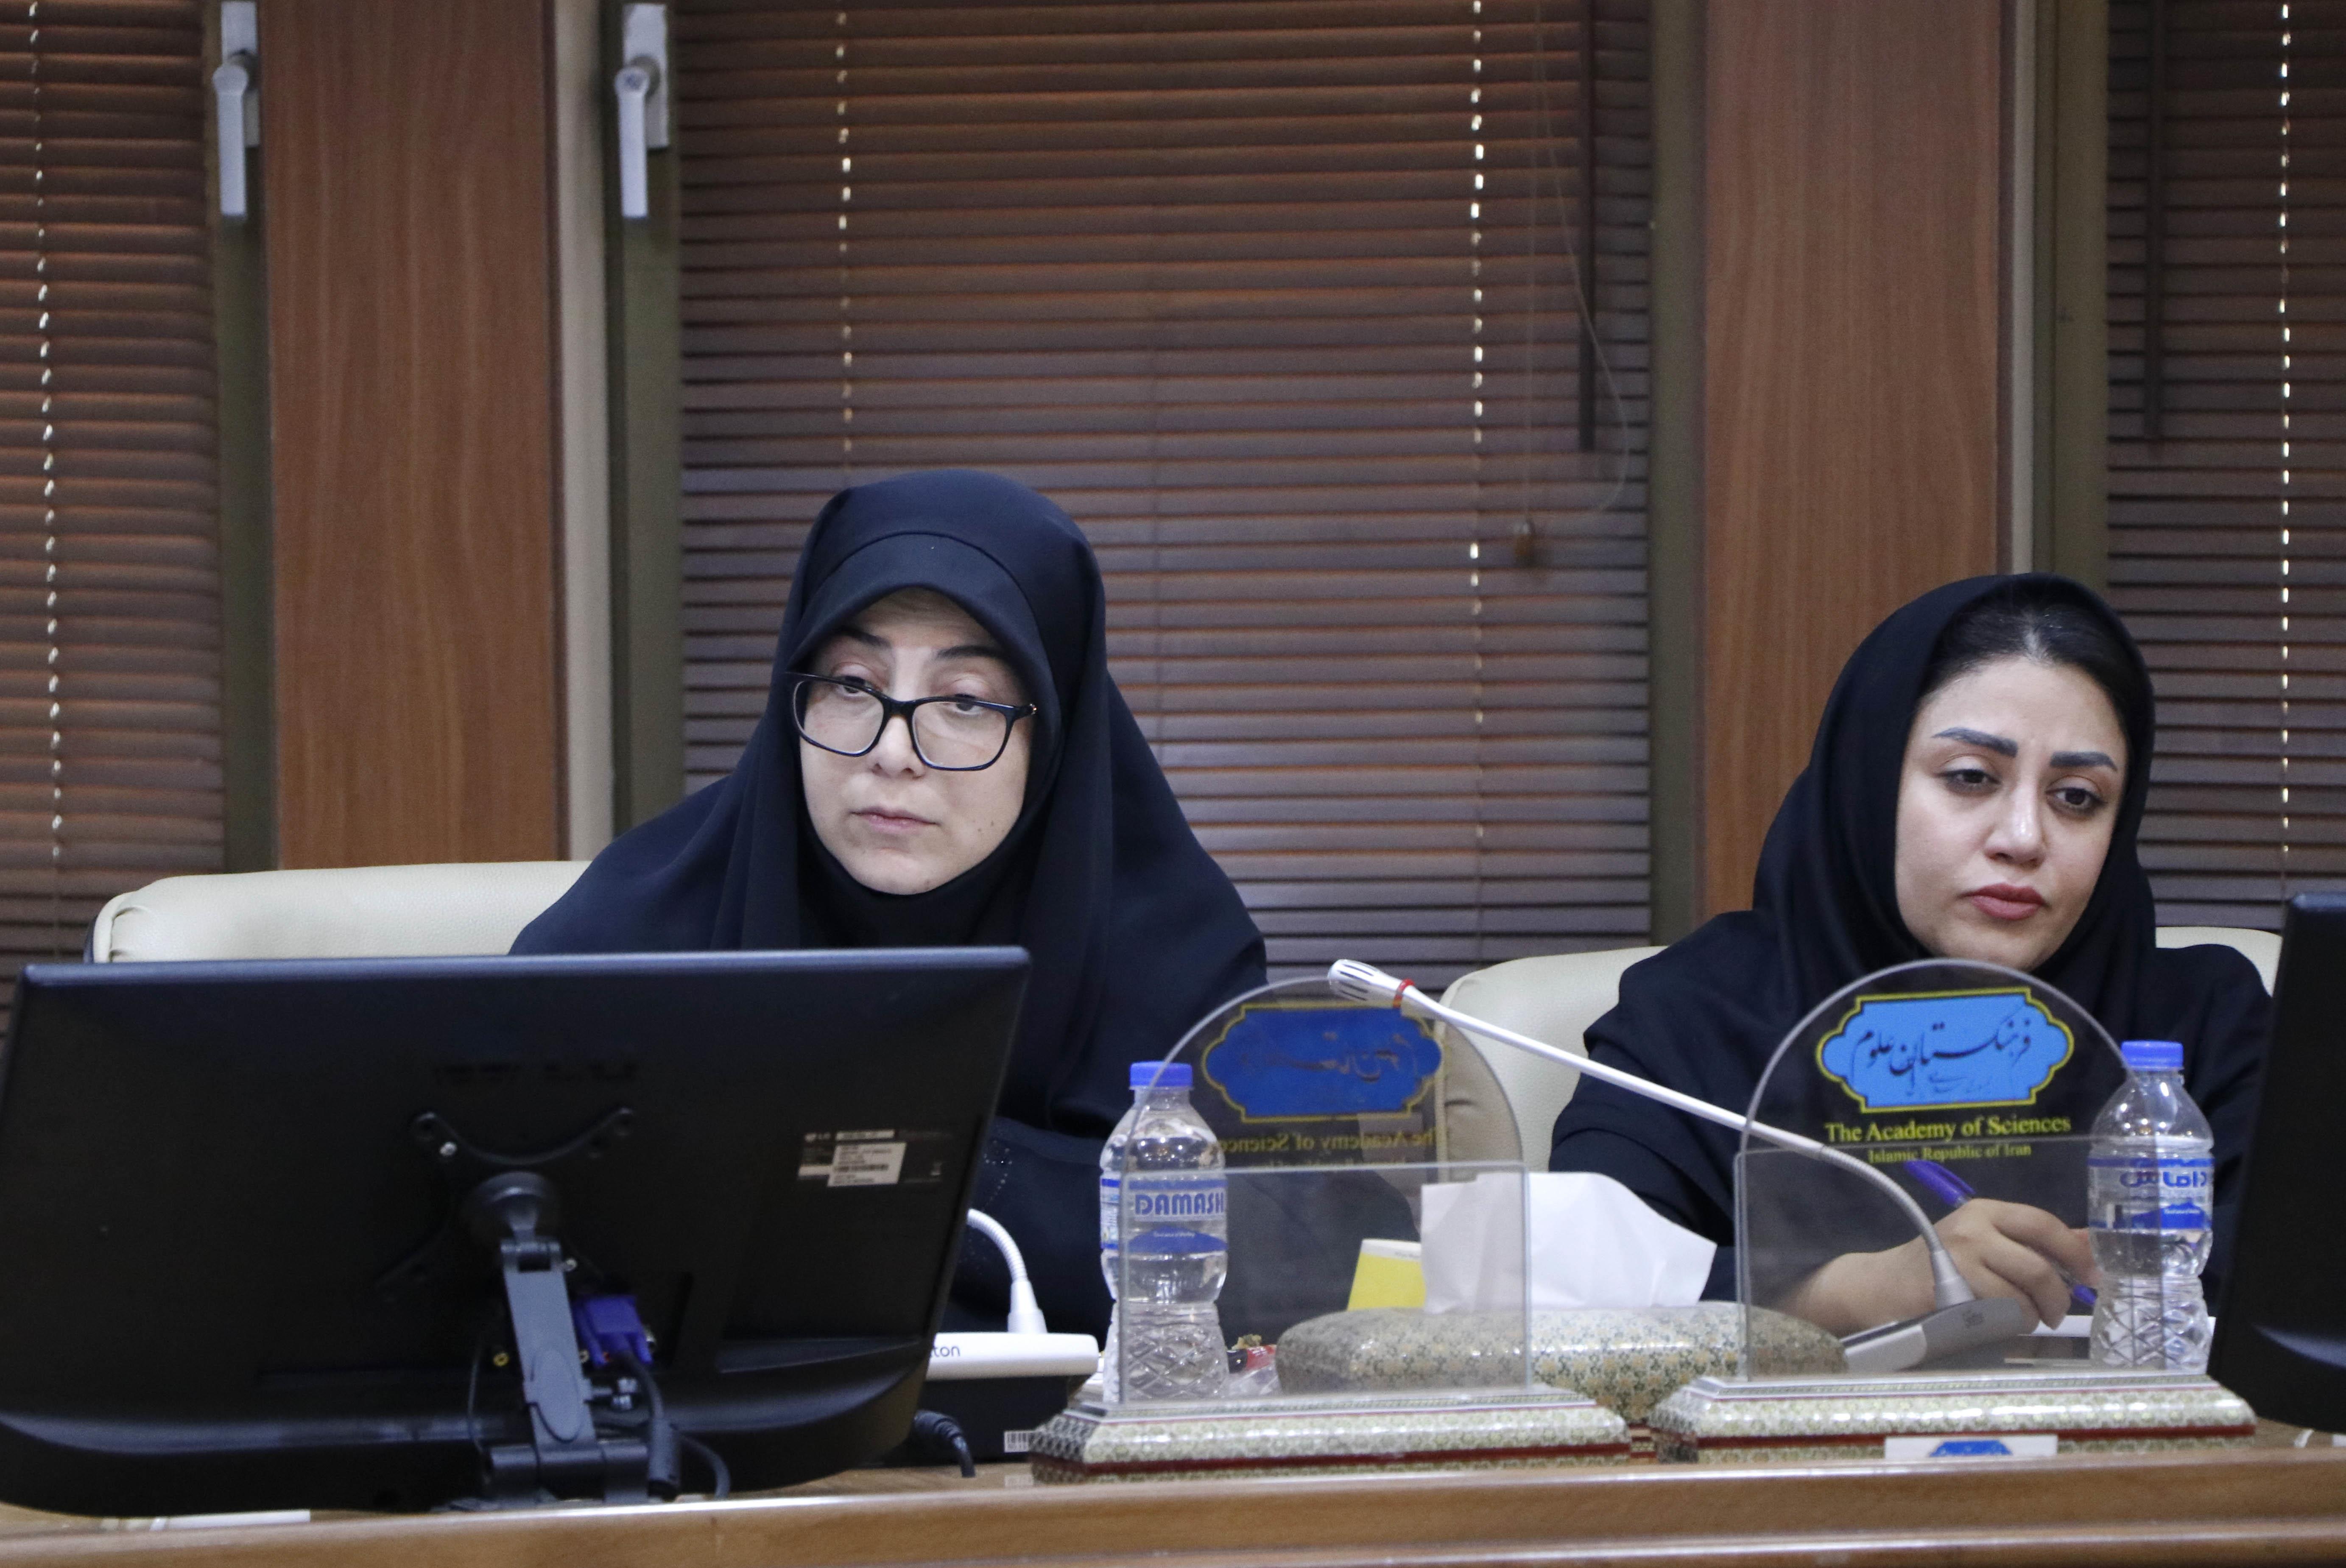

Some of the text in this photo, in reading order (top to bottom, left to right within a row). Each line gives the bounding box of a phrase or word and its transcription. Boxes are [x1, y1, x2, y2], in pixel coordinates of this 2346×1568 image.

[1825, 1114, 2070, 1142] The Academy of Sciences
[1868, 1144, 2032, 1164] Islamic Republic of Iran
